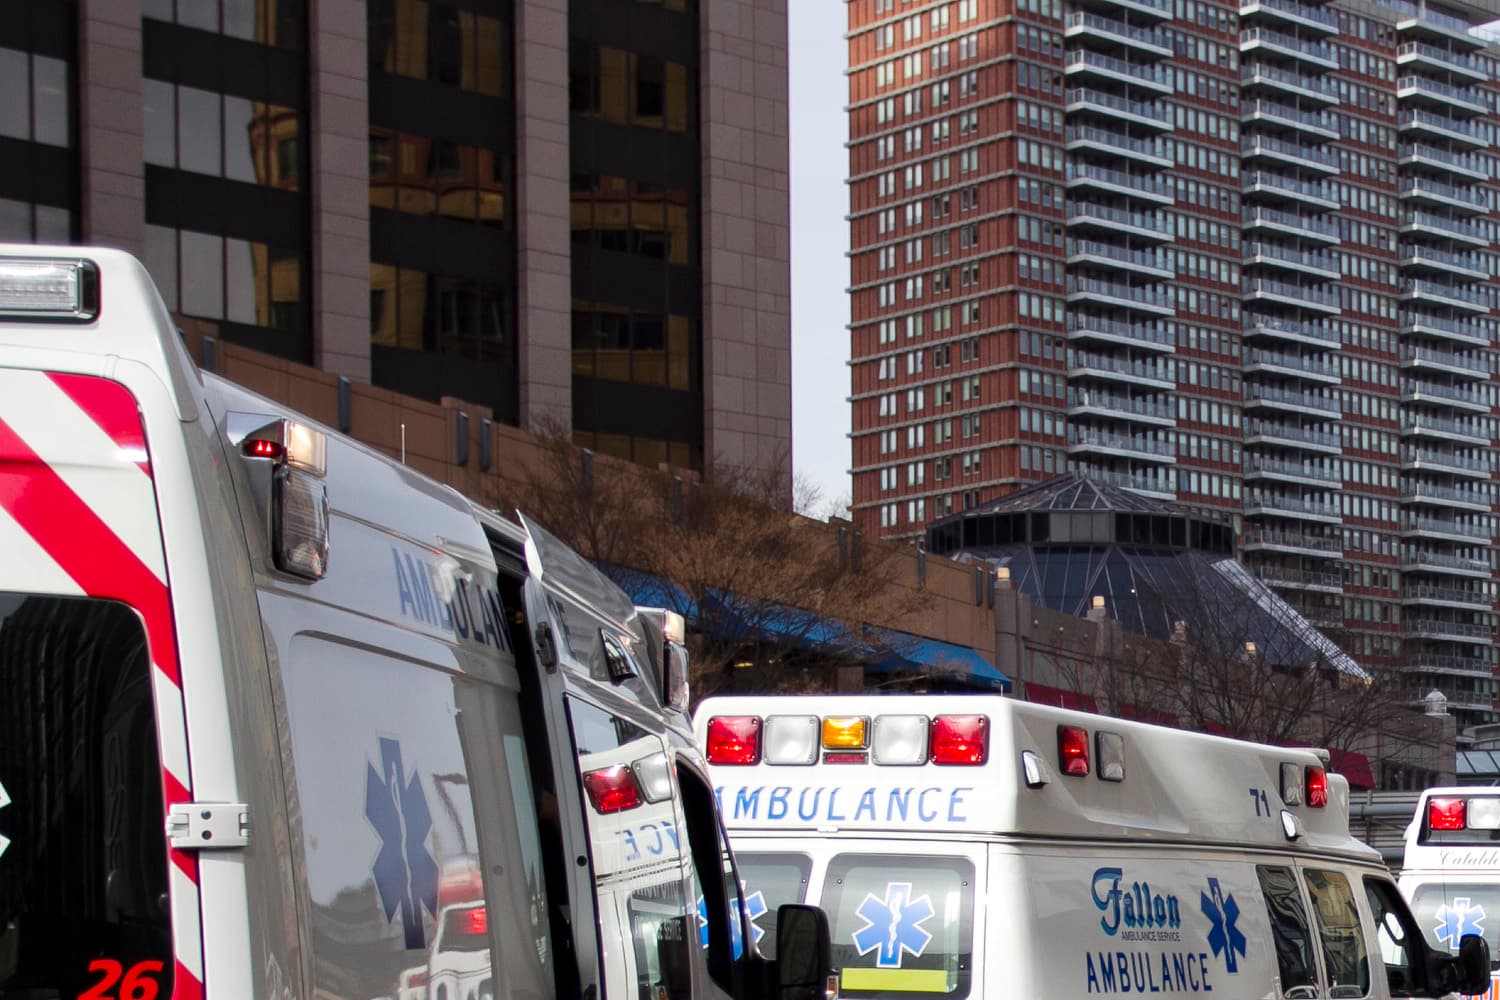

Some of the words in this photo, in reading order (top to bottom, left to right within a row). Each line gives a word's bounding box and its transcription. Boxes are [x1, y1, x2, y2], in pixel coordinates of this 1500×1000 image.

[1248, 788, 1271, 817] 71
[1091, 867, 1182, 937] Fallon
[1086, 951, 1213, 993] AMBULANCE
